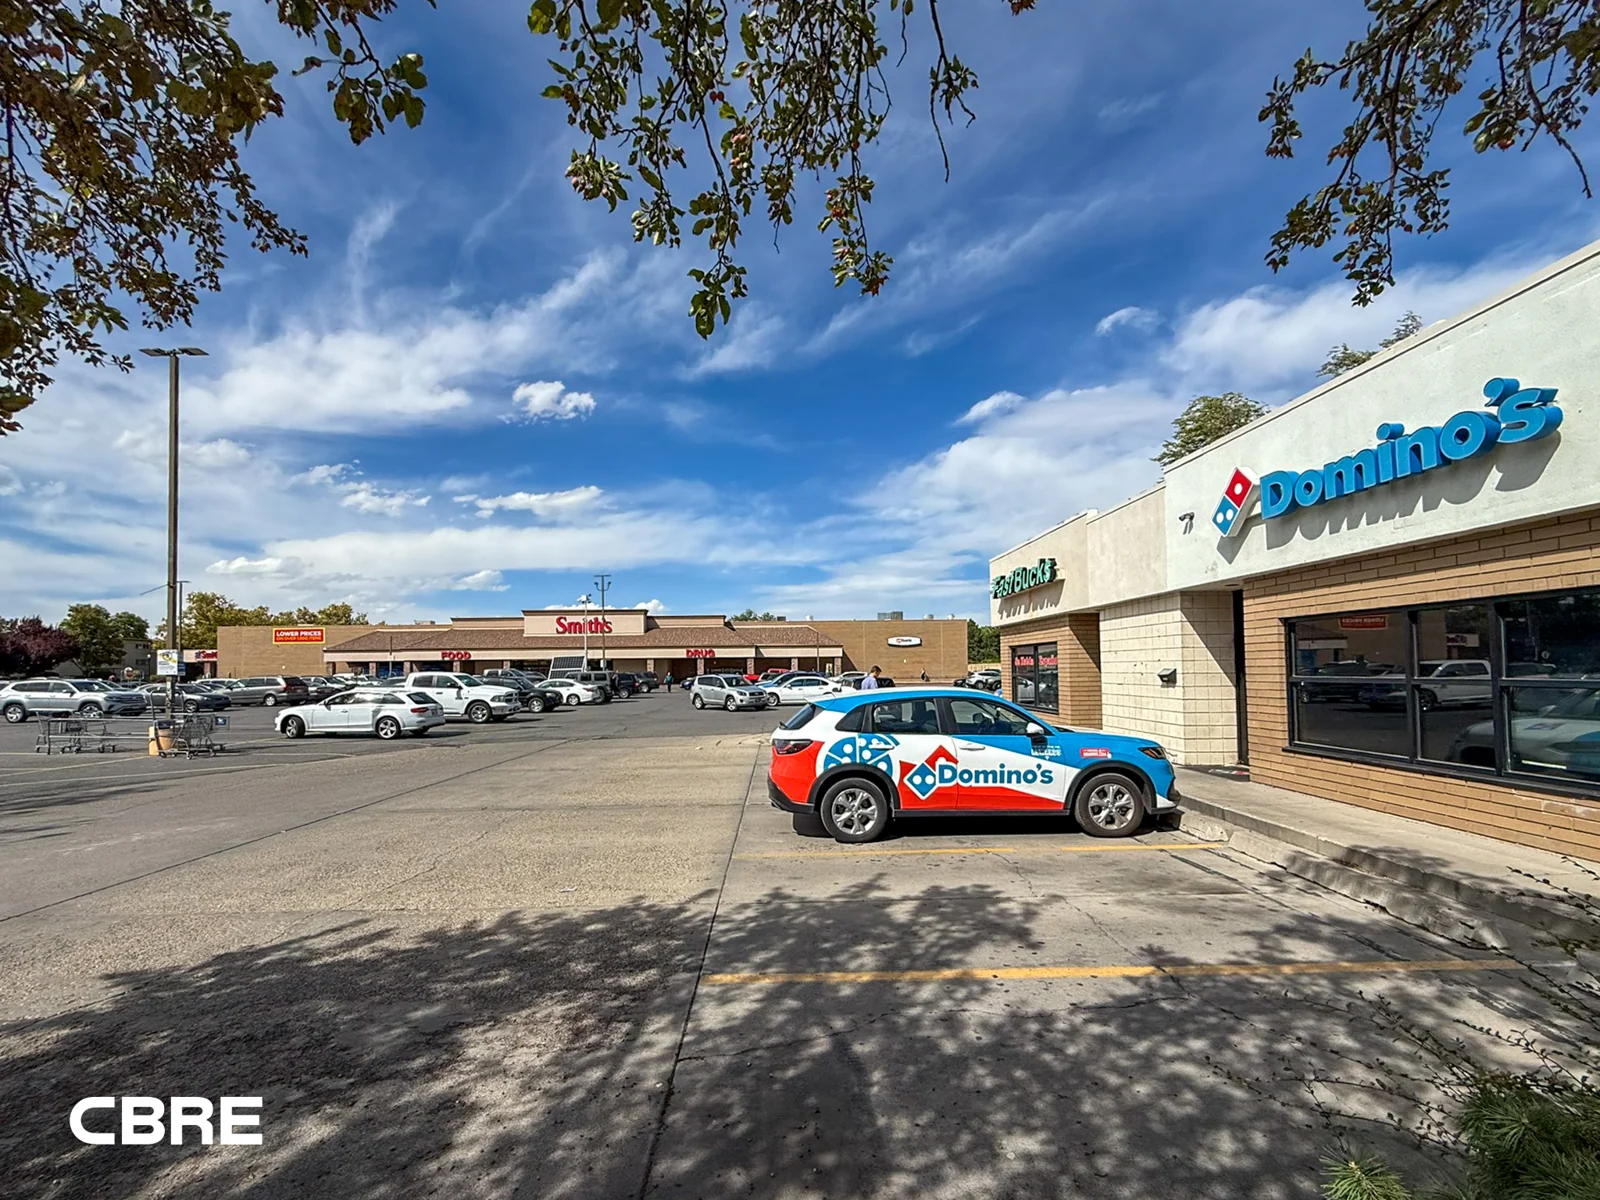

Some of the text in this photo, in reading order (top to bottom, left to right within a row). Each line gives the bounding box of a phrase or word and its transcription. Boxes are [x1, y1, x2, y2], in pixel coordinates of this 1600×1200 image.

[1260, 377, 1564, 520] Domino's
[441, 651, 472, 660] FOOD
[686, 649, 716, 658] DRUG
[938, 763, 1054, 784] Domino's
